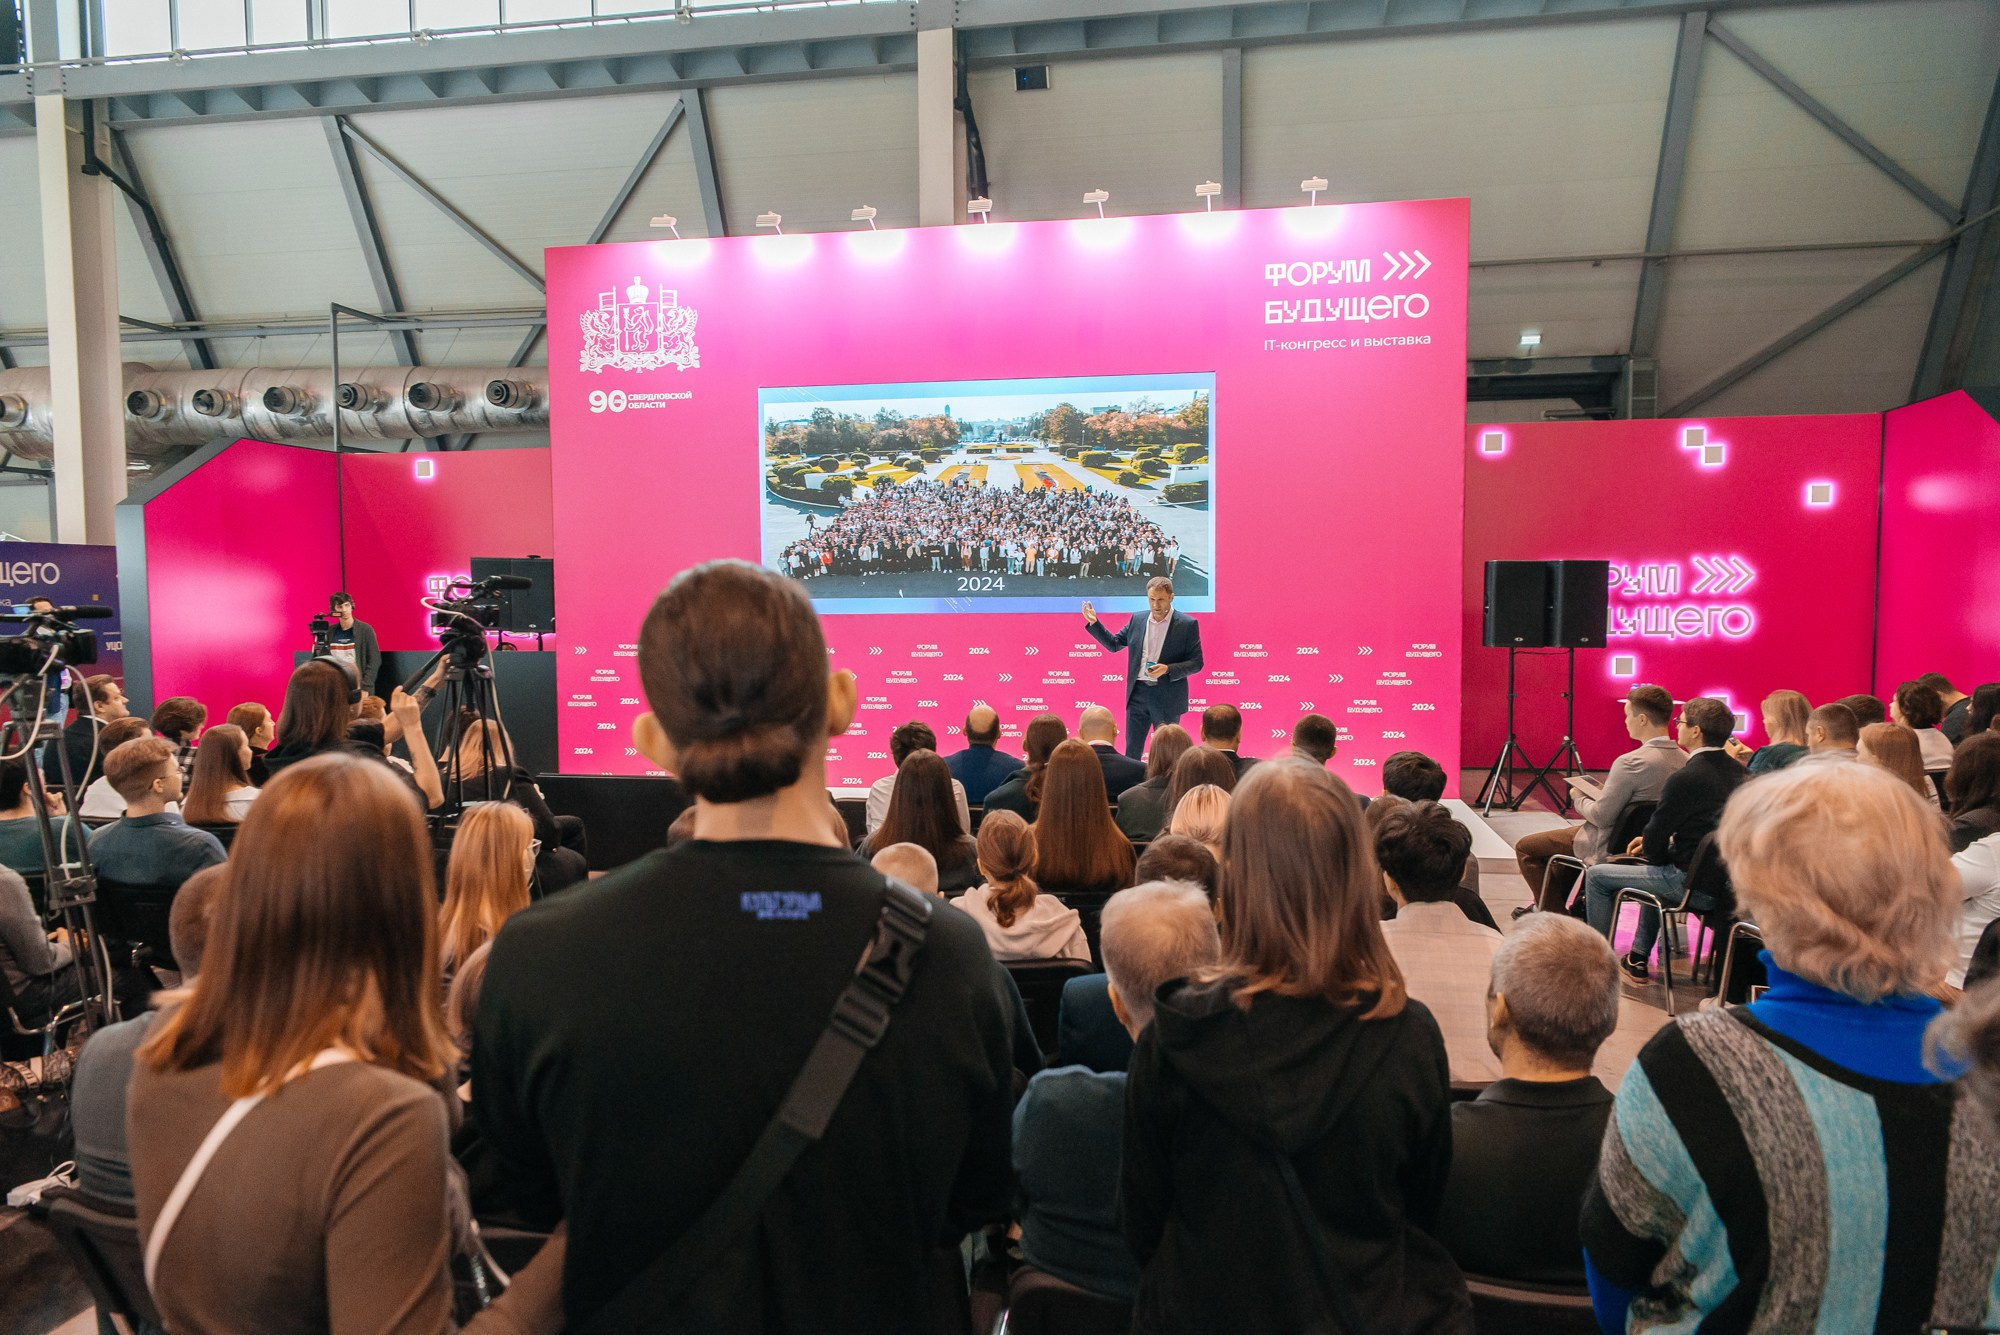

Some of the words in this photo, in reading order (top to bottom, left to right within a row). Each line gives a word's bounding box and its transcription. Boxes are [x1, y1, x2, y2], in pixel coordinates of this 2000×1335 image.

[1264, 258, 1371, 287] ФОРУМ
[1264, 338, 1347, 351] IT-конгресс
[1350, 338, 1360, 348] и
[1363, 335, 1431, 347] выставка
[588, 389, 627, 413] 90
[628, 390, 692, 401] СВЕРДЛОВСКОЙ
[628, 401, 666, 409] ОБЛАСТИ
[957, 576, 1006, 592] 2024
[1609, 566, 1678, 593] РУМ
[1296, 646, 1320, 654] 2024
[1268, 674, 1290, 682] 2024
[1240, 702, 1262, 710] 2024
[1382, 730, 1406, 738] 2024
